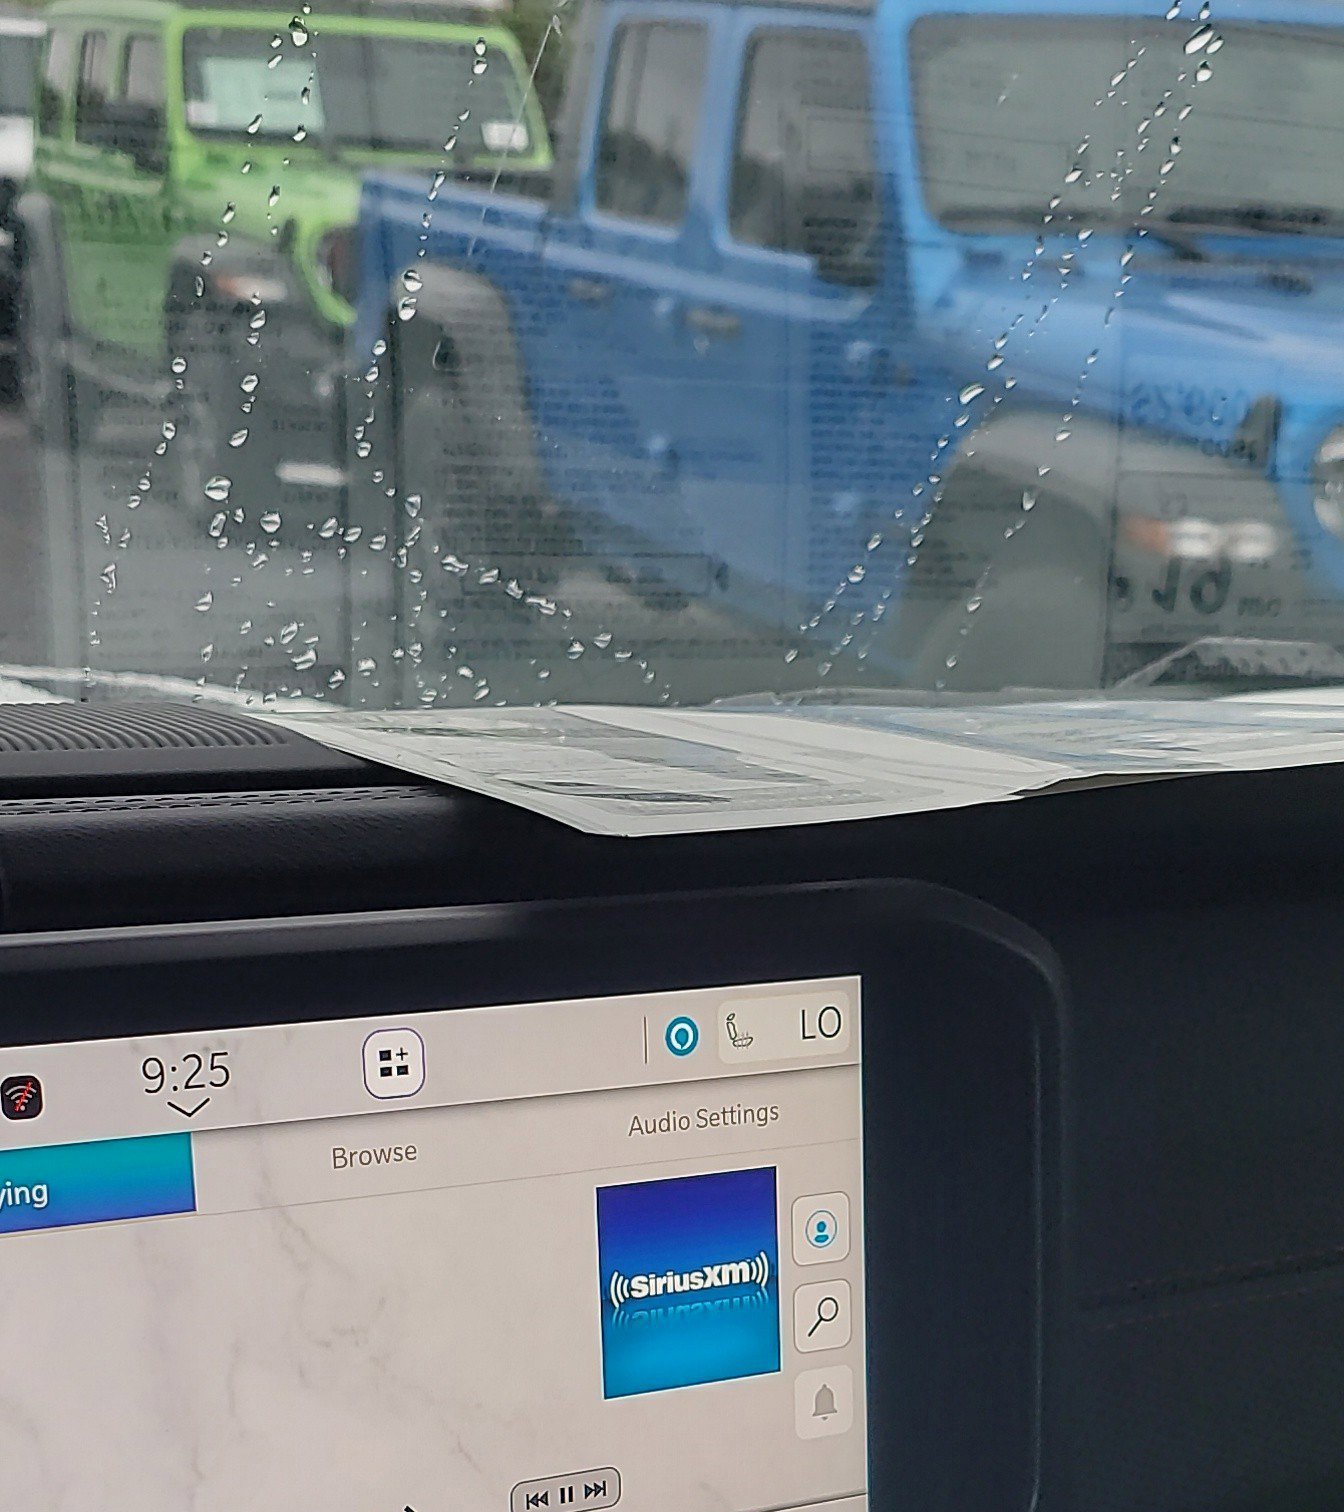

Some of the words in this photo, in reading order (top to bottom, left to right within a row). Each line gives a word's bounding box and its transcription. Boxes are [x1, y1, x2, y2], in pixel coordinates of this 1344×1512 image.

[800, 1005, 842, 1041] LO
[141, 1051, 232, 1096] 9:25
[628, 1110, 692, 1138] Audio
[696, 1103, 781, 1134] Settings
[331, 1140, 419, 1171] Browse
